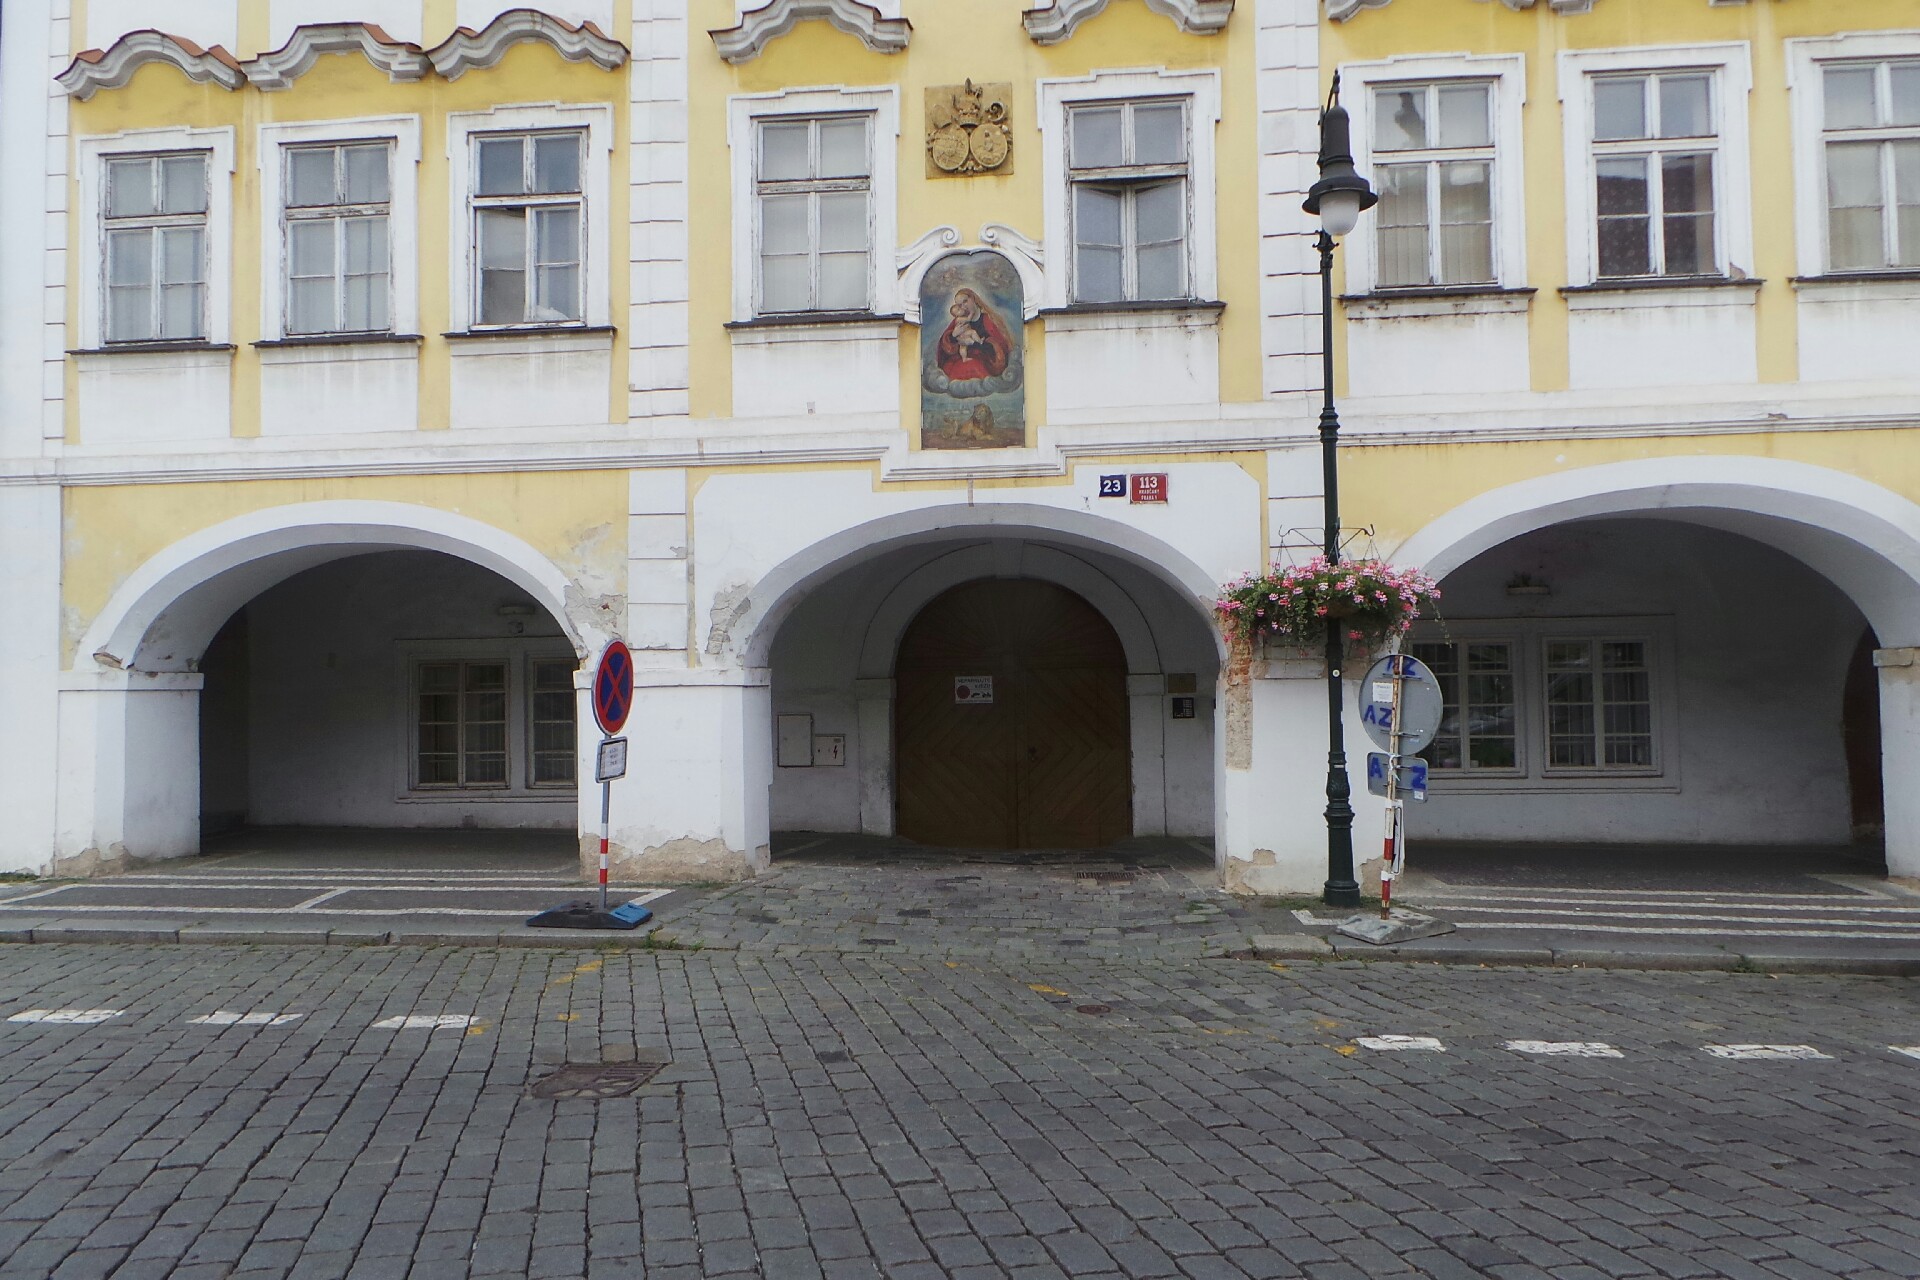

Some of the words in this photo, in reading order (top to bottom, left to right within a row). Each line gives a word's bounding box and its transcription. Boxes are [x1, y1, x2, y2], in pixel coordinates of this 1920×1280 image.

[1103, 480, 1121, 492] 23
[1139, 476, 1158, 488] 113
[1364, 705, 1392, 727] AZ
